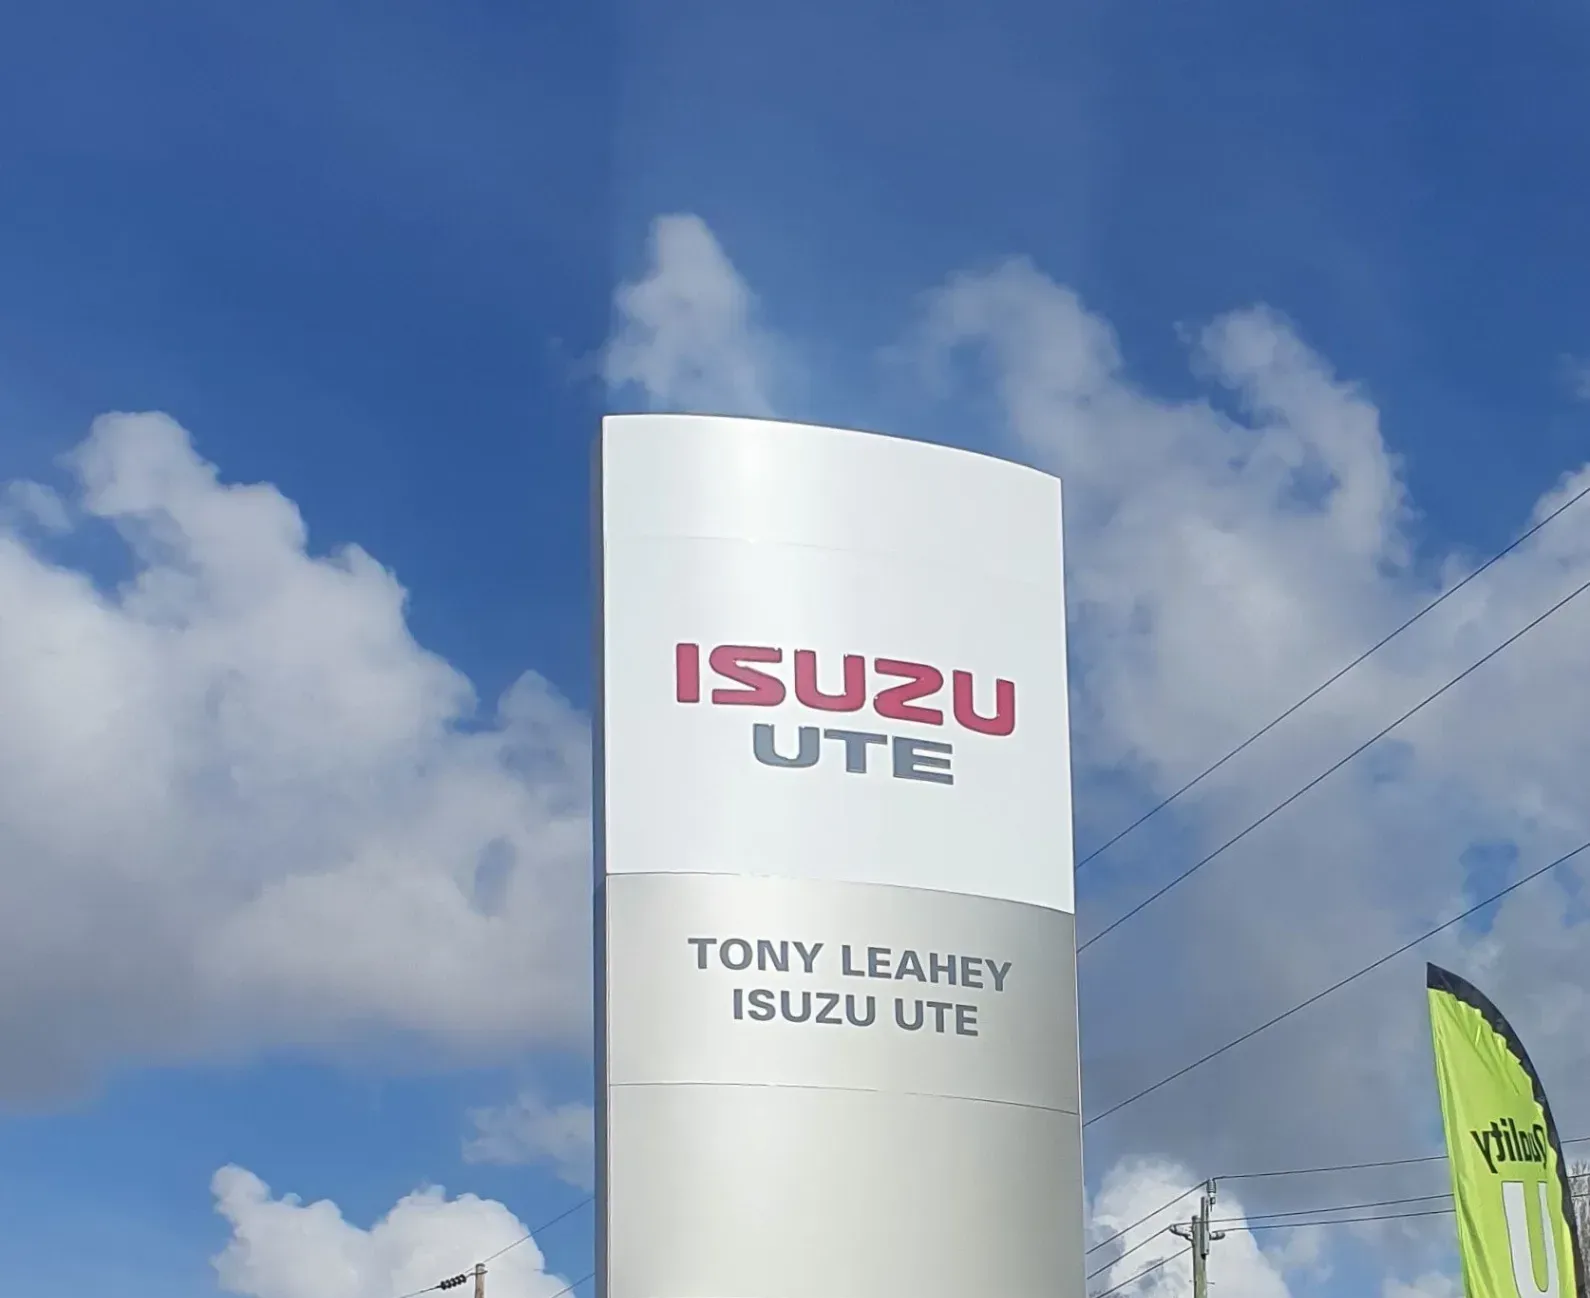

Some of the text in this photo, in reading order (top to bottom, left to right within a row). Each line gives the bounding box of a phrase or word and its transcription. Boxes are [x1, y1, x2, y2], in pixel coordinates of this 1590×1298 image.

[676, 643, 1015, 736] ISUZU
[753, 723, 954, 785] UTE
[688, 938, 1012, 992] TONY LEAHEY
[733, 988, 979, 1036] ISUZU UTE
